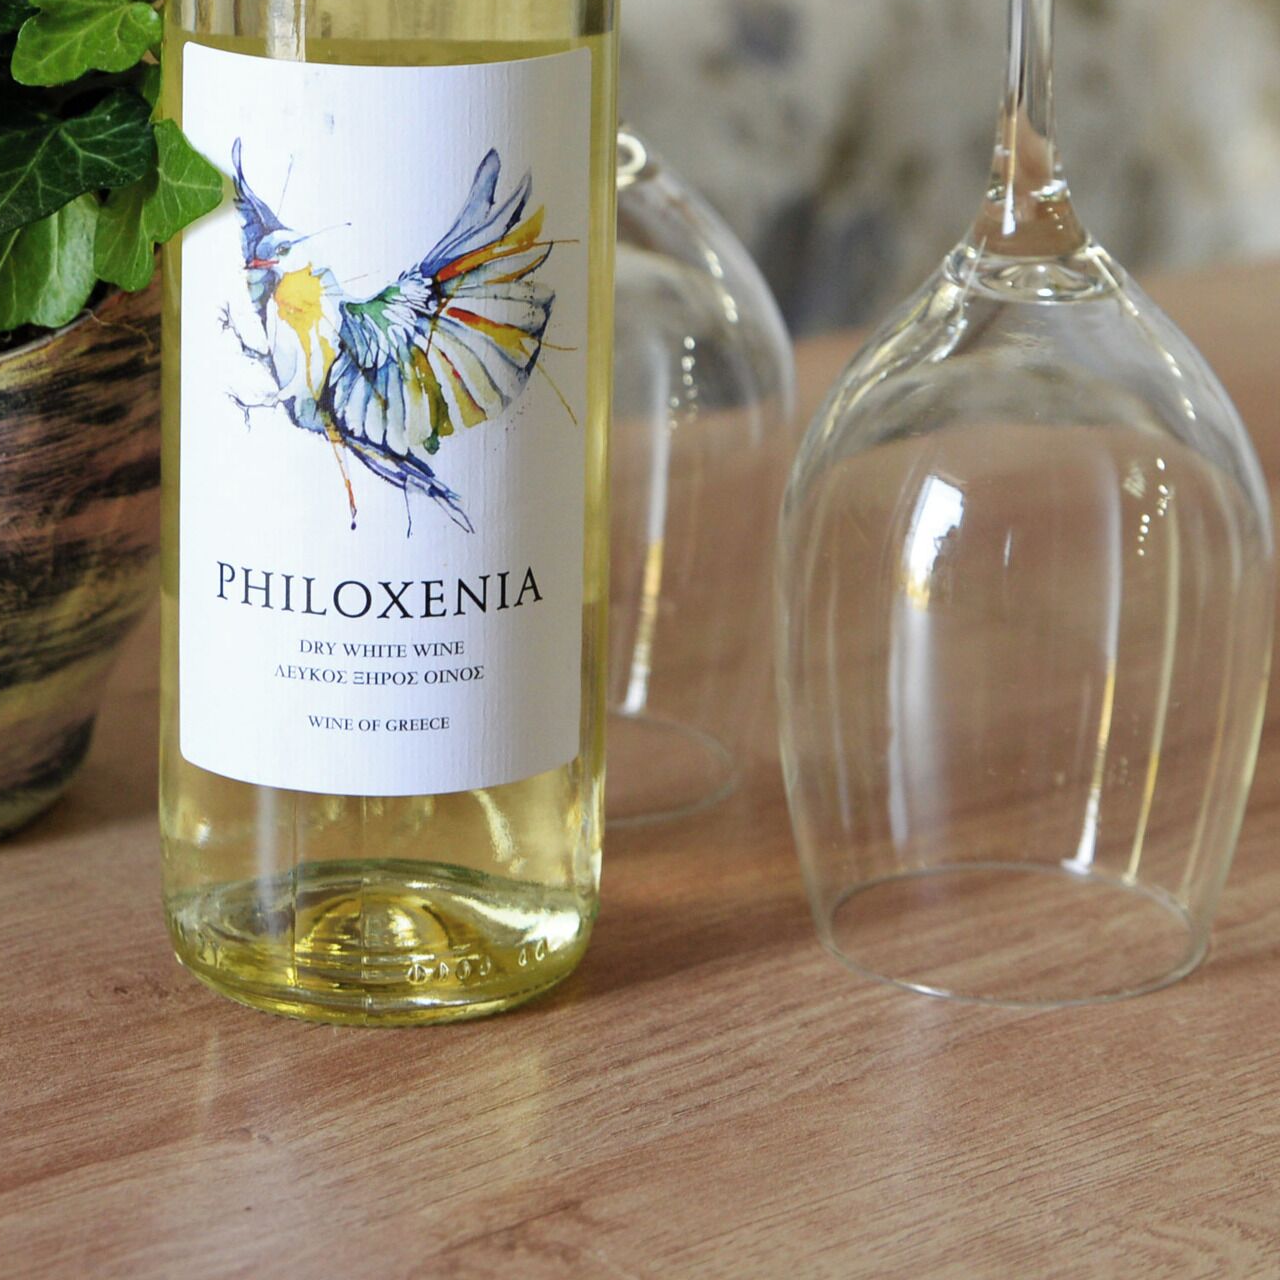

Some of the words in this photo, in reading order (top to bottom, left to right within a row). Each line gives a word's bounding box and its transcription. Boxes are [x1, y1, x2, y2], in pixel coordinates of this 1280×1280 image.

[216, 561, 543, 620] PHILOXENIA
[299, 639, 337, 657] DRY
[343, 642, 408, 659] WHITE
[413, 640, 465, 658] WINE
[274, 664, 348, 685] ΛΕΥΚΟΣ
[353, 670, 419, 686] ΞΗΡΟΣ
[423, 664, 485, 685] ΟΙΝΟΣ
[308, 714, 354, 731] WINE
[358, 717, 381, 732] OF
[385, 716, 450, 732] GREECE
